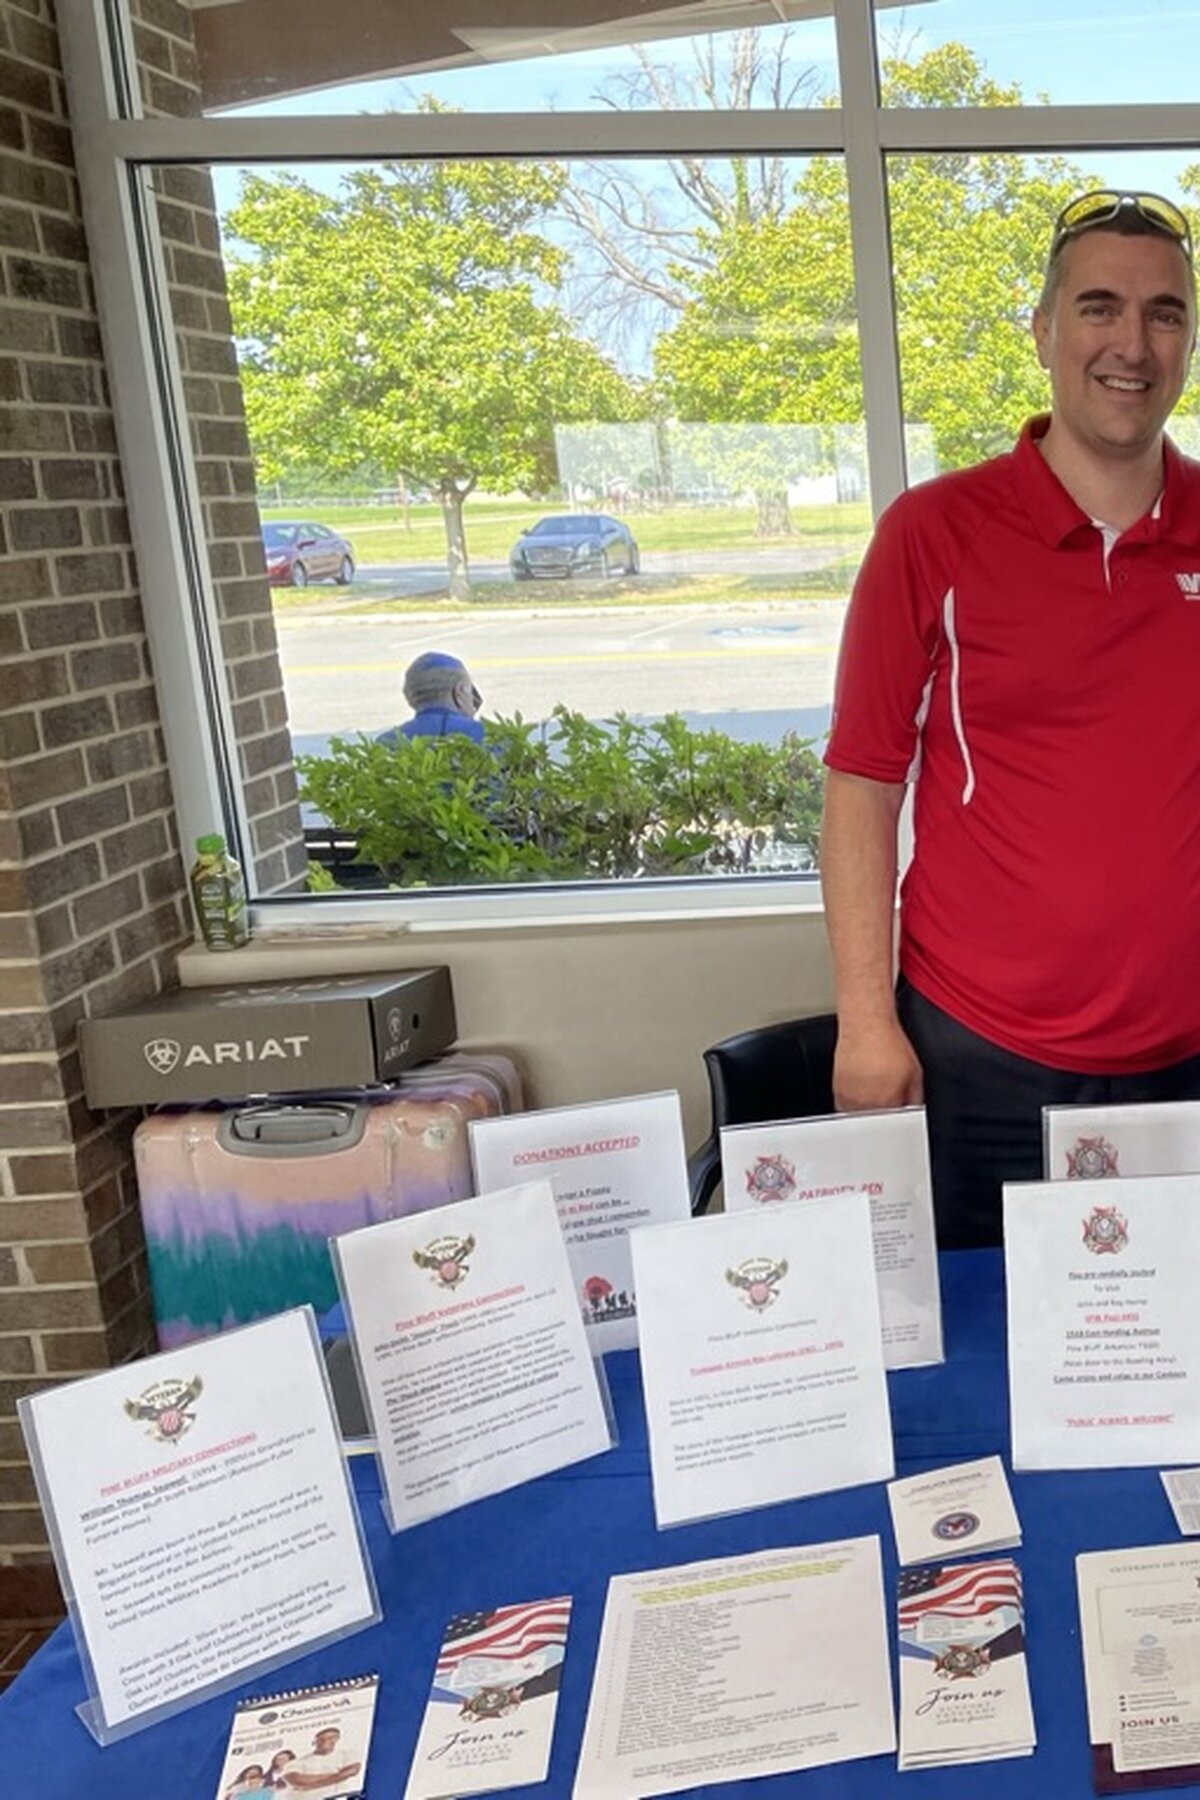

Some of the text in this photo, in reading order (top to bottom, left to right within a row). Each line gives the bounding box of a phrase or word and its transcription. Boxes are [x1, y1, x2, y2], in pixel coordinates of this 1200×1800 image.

[184, 1035, 310, 1068] ARIAT
[513, 1136, 641, 1166] DONATIONS ACCEPTED
[915, 1687, 1006, 1716] Join us
[1120, 1715, 1180, 1729] JOIN US
[427, 1729, 528, 1761] Join us
